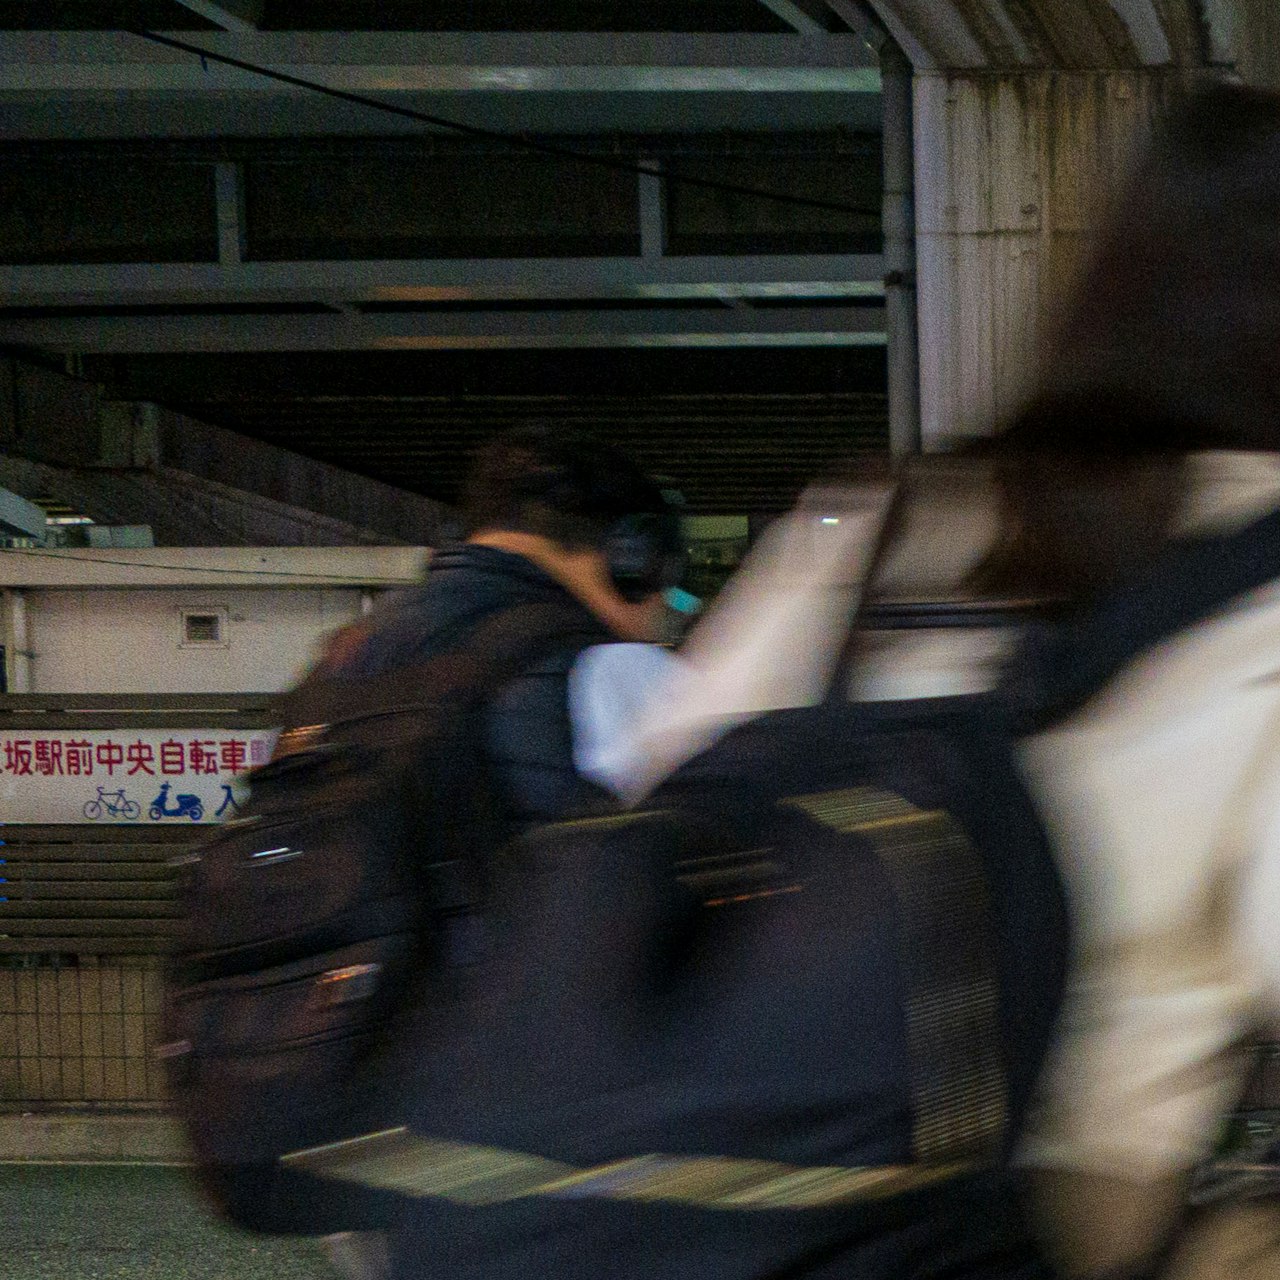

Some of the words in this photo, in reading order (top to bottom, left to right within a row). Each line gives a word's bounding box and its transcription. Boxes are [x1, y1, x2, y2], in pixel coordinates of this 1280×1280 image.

[0, 739, 267, 776] 坂駅前中央自転車
